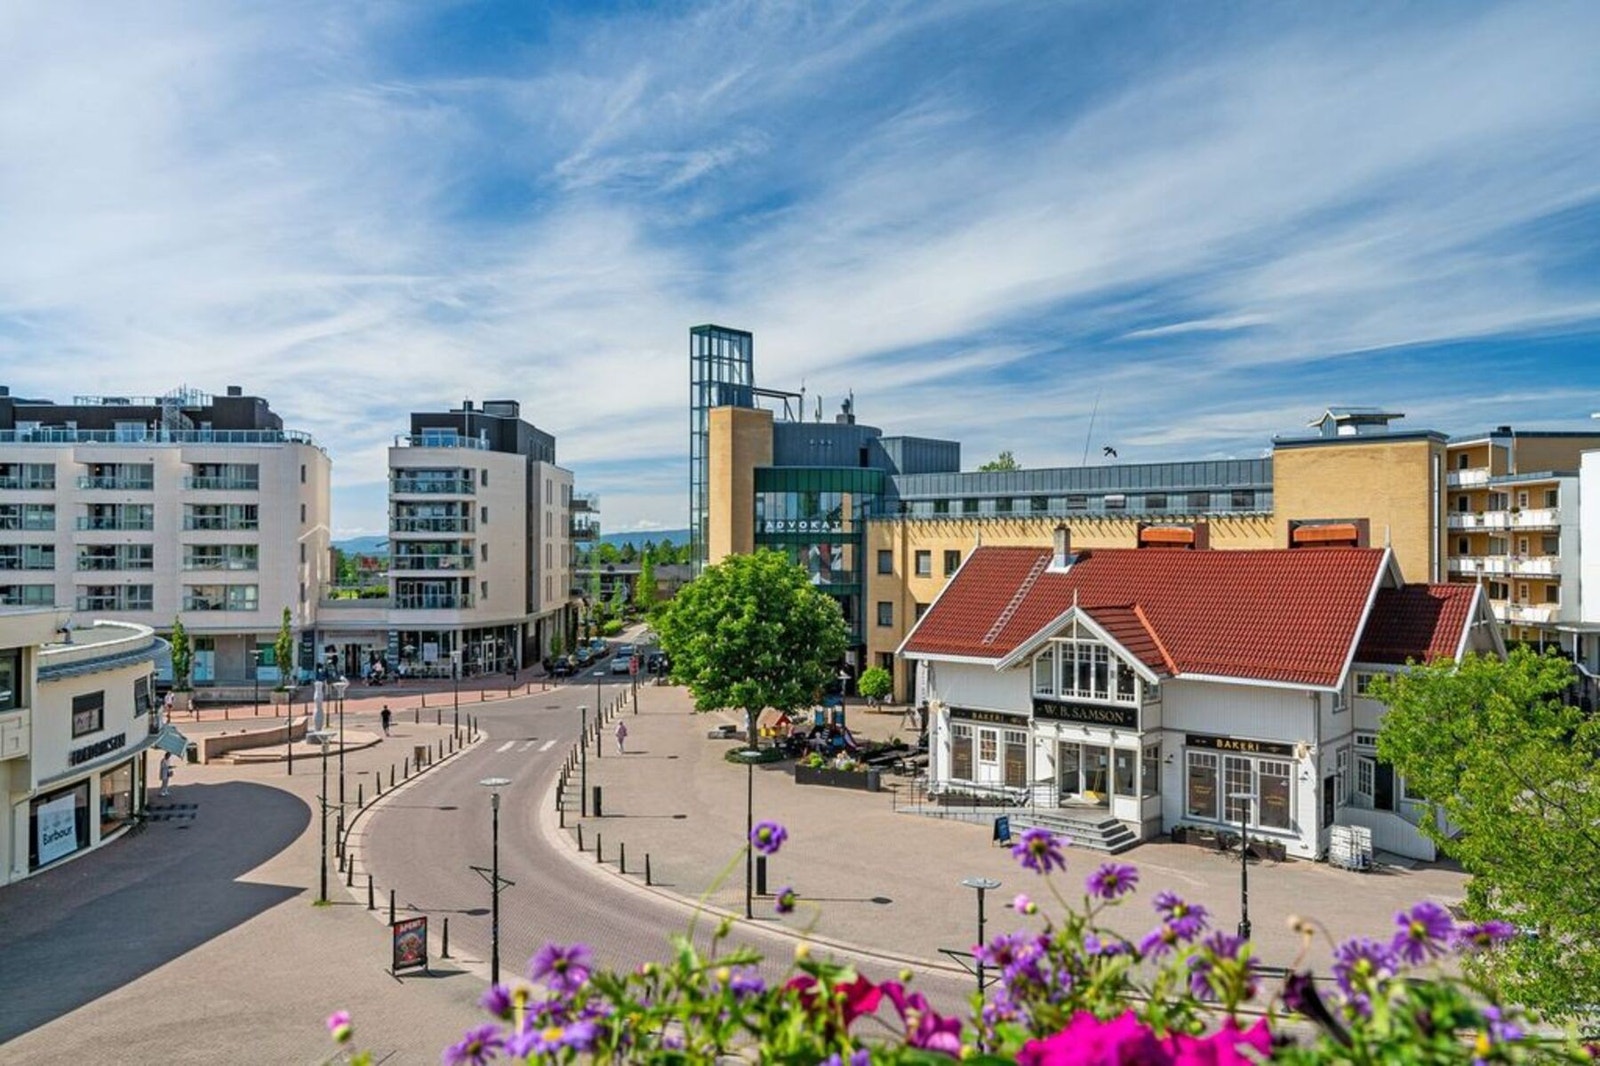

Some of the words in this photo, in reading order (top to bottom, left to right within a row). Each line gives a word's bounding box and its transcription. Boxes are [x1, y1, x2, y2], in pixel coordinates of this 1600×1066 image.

[765, 520, 840, 529] ADVOKAT
[972, 712, 1004, 721] BAKERI
[1072, 707, 1124, 722] SAMSON
[1216, 739, 1259, 751] BAKERI
[43, 826, 73, 846] Barbour
